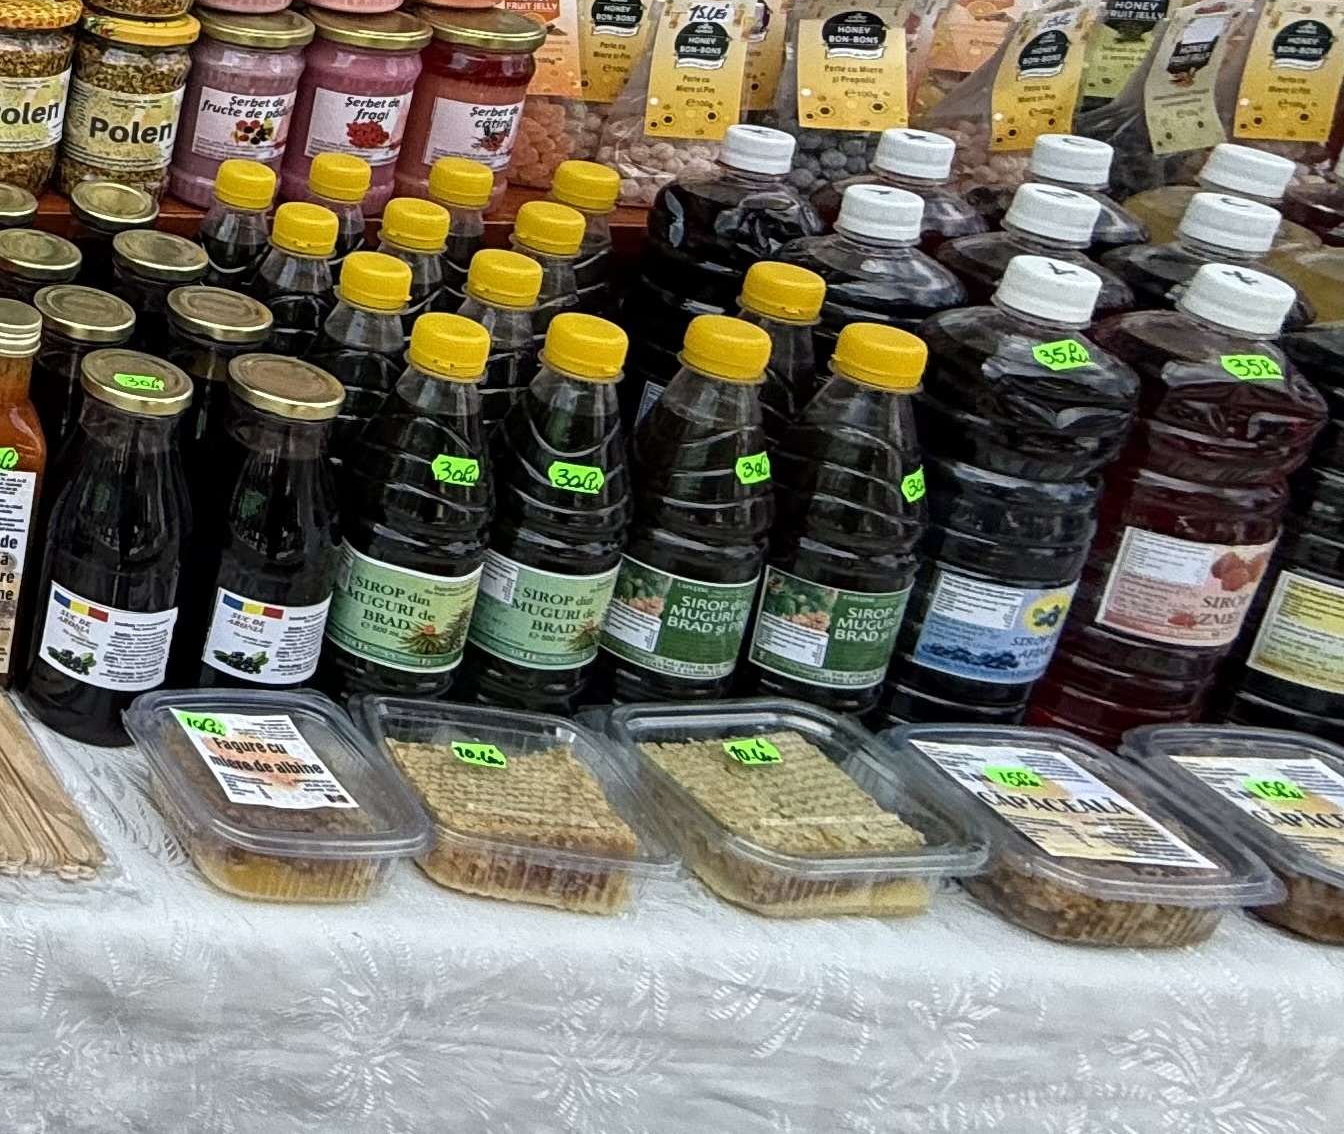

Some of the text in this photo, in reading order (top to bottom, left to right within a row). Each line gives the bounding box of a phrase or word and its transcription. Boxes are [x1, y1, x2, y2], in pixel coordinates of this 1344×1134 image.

[1113, 0, 1160, 12] HONEY
[837, 26, 871, 34] HONEY
[829, 35, 879, 44] BON-BONS
[201, 101, 264, 119] fructe de
[266, 96, 285, 107] de
[384, 97, 400, 108] de
[90, 117, 172, 143] Polen
[1, 533, 19, 550] de
[355, 576, 431, 607] SIROP din
[522, 586, 594, 606] SIROP din
[348, 587, 436, 622] MUGURI de
[512, 601, 596, 622] MUGURI de
[681, 595, 730, 612] SIROP
[362, 608, 412, 632] BRAD
[670, 605, 734, 624] MUGURI
[847, 606, 894, 620] SIROP
[531, 617, 577, 636] BRAD
[667, 617, 713, 634] BRAD
[834, 628, 880, 642] BRAD
[212, 736, 287, 755] Fagure cu
[252, 760, 272, 773] de
[276, 760, 325, 775] albine
